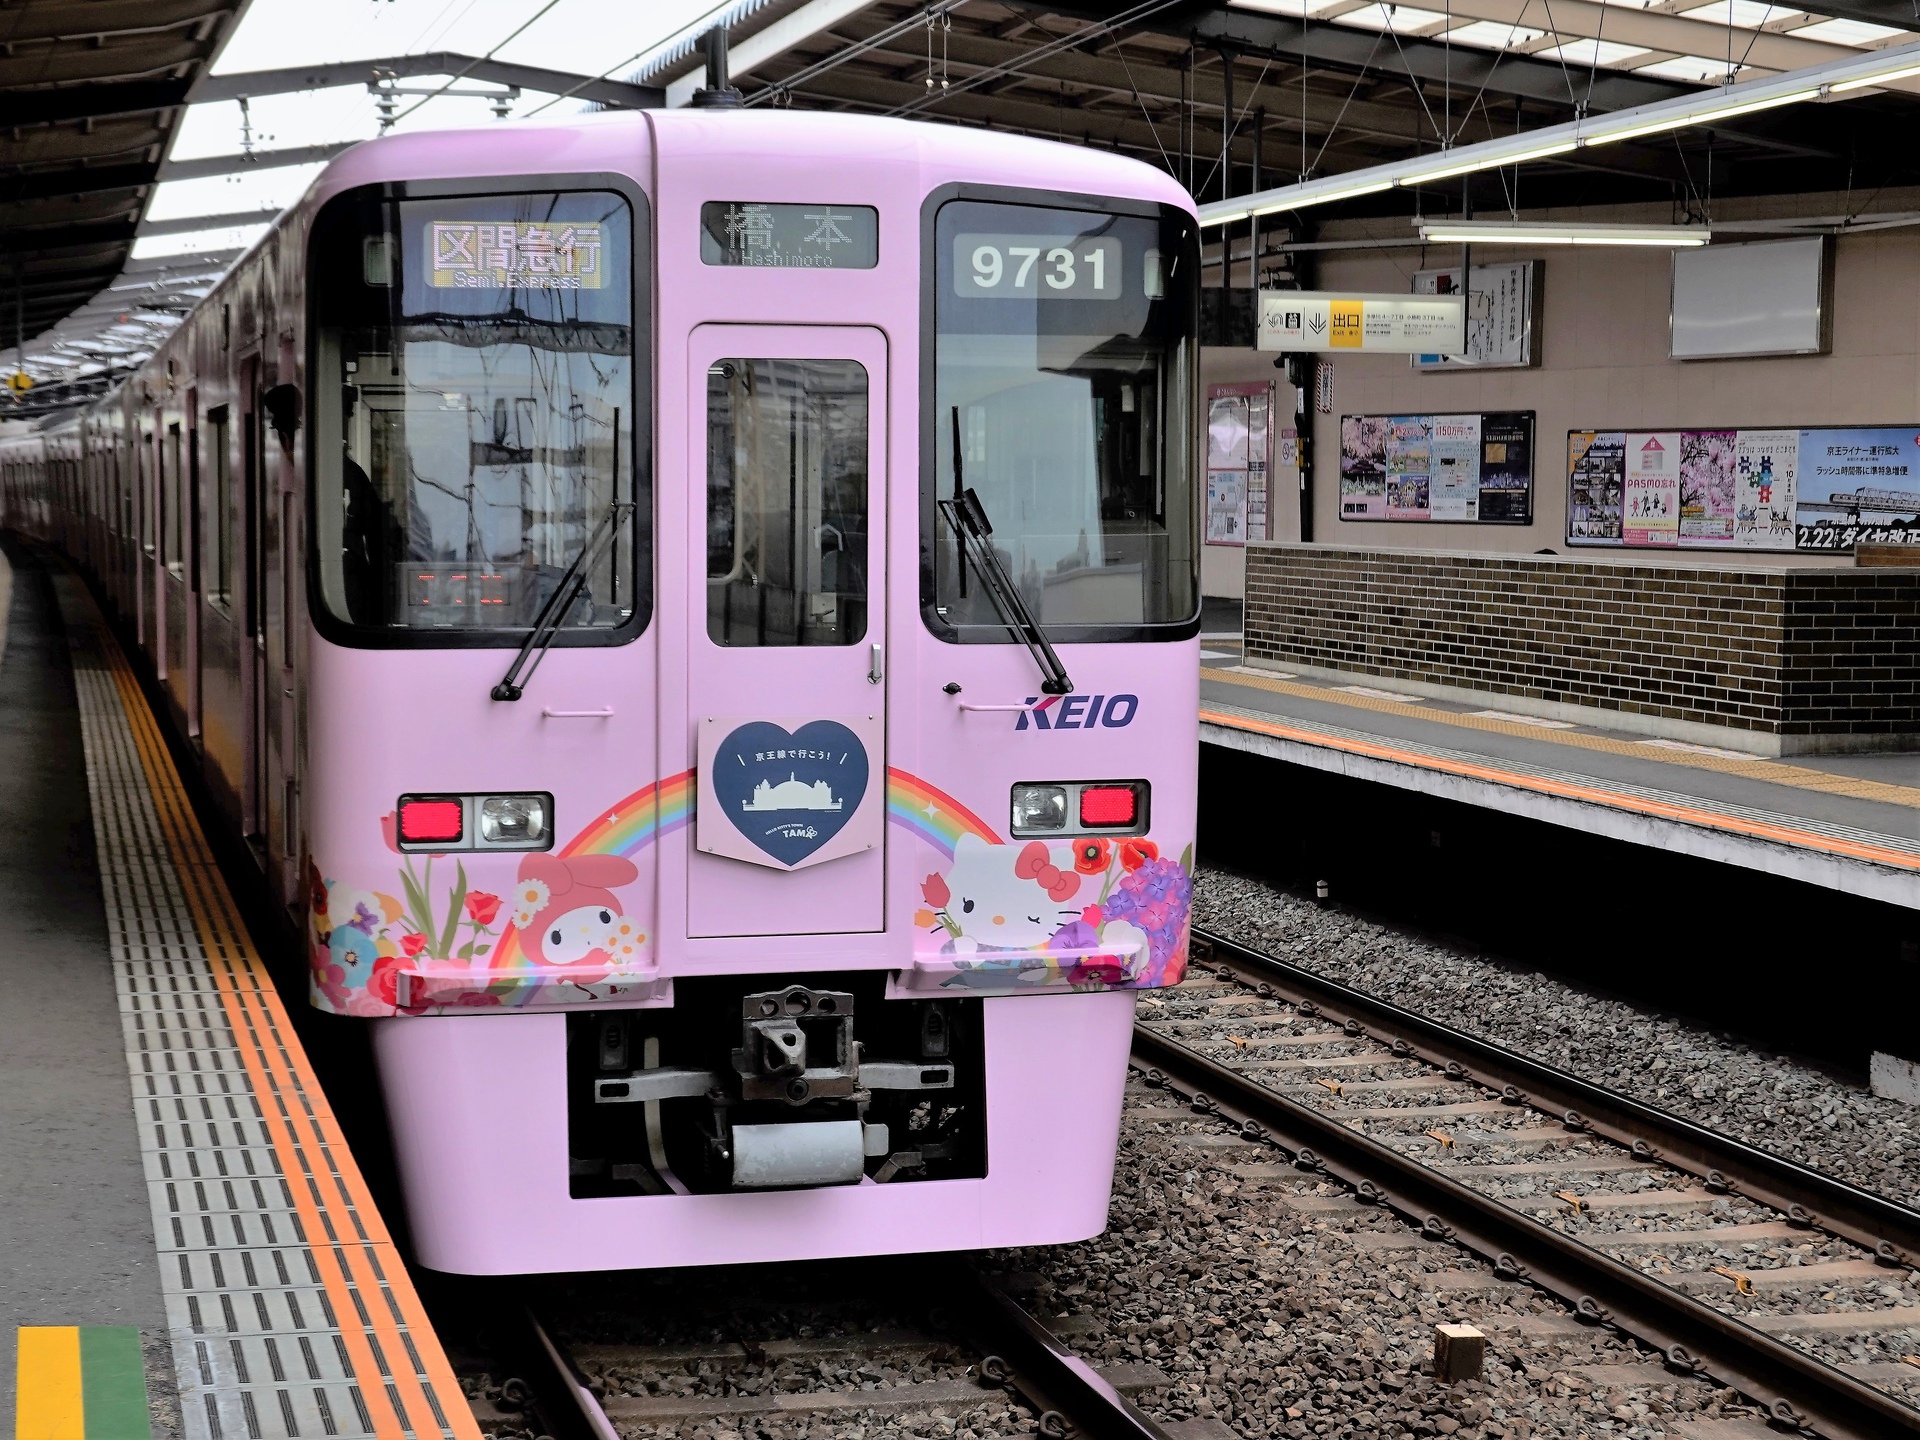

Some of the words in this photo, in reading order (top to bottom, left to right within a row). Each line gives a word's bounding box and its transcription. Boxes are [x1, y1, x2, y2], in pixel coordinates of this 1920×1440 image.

[433, 224, 601, 273] 区間急行
[741, 250, 833, 268] Hashimoto
[972, 245, 1105, 290] 9731
[1332, 312, 1360, 328] 出口
[1826, 445, 1900, 456] 京王ライナー運行拡大
[1816, 465, 1909, 477] ラッシュ時間帯に準特急増便
[1627, 479, 1676, 489] PASMO忘れ
[1797, 527, 1834, 548] 2.22
[1015, 694, 1139, 731] KEIO
[765, 827, 778, 836] HELLO
